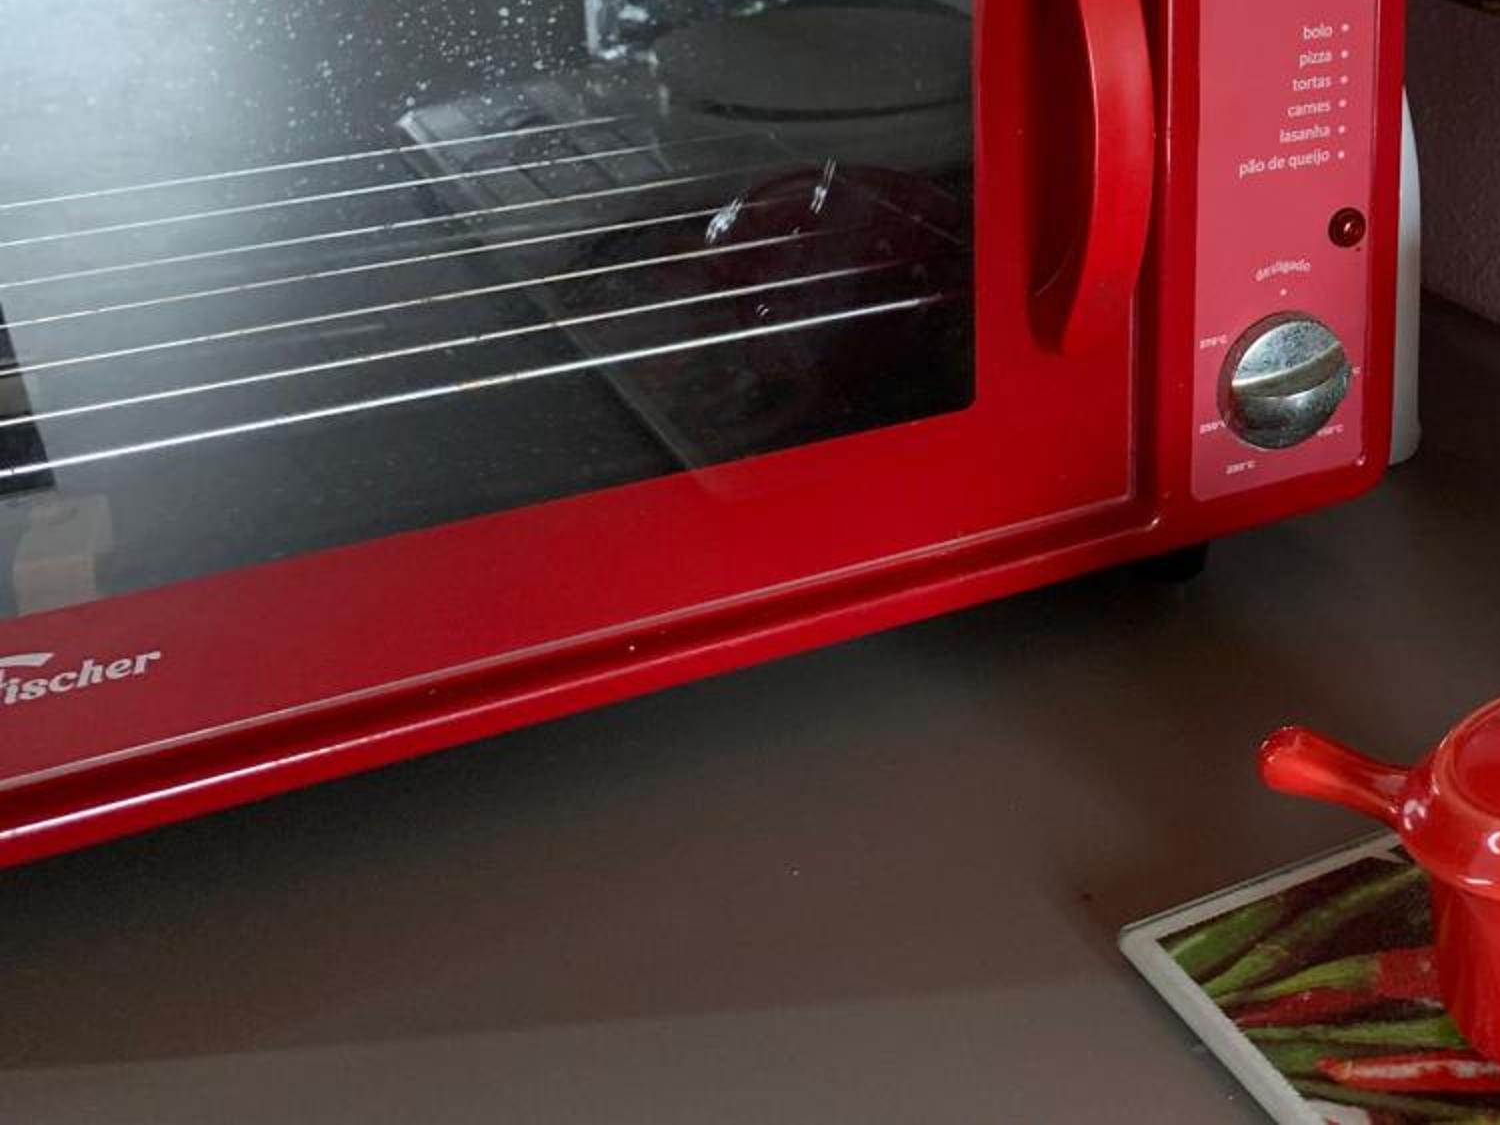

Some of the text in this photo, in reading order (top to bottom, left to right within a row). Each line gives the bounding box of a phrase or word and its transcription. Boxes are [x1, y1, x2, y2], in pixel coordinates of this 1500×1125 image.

[1303, 23, 1333, 40] bolo
[1300, 51, 1333, 69] pizza
[1292, 76, 1332, 91] tortas
[1287, 101, 1331, 118] carnes
[1279, 125, 1331, 143] lasanha
[1239, 148, 1330, 179] pão de queijo
